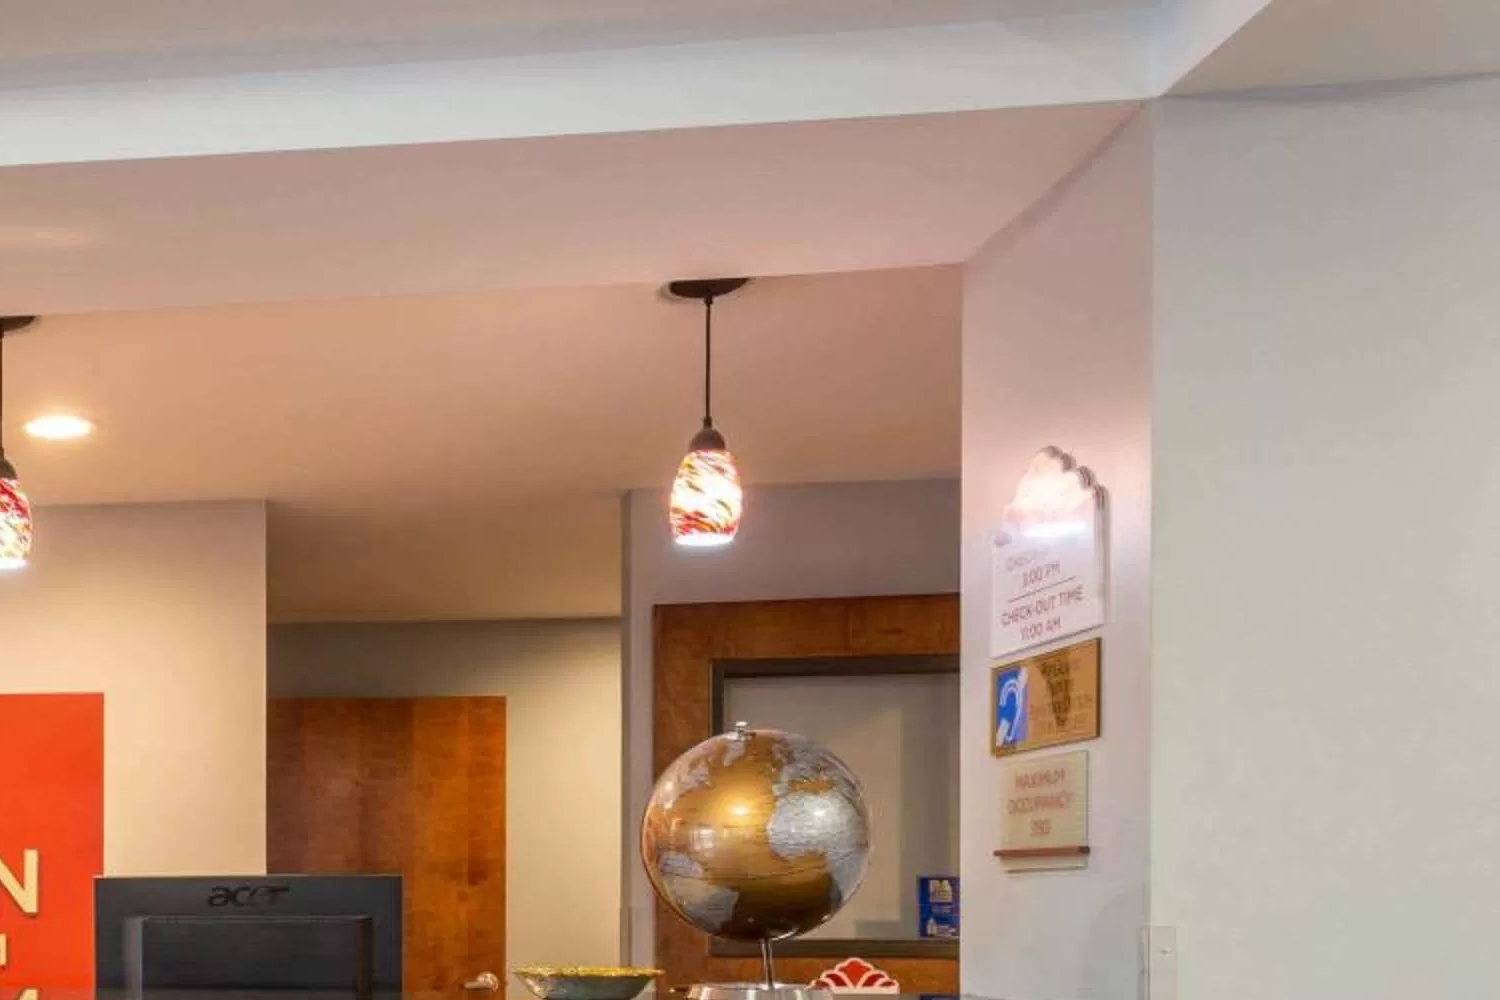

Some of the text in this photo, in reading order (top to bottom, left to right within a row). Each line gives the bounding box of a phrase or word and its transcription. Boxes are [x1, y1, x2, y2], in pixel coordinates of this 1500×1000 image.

[1001, 584, 1084, 628] CHECK-OUT TIME
[1045, 616, 1061, 631] AM
